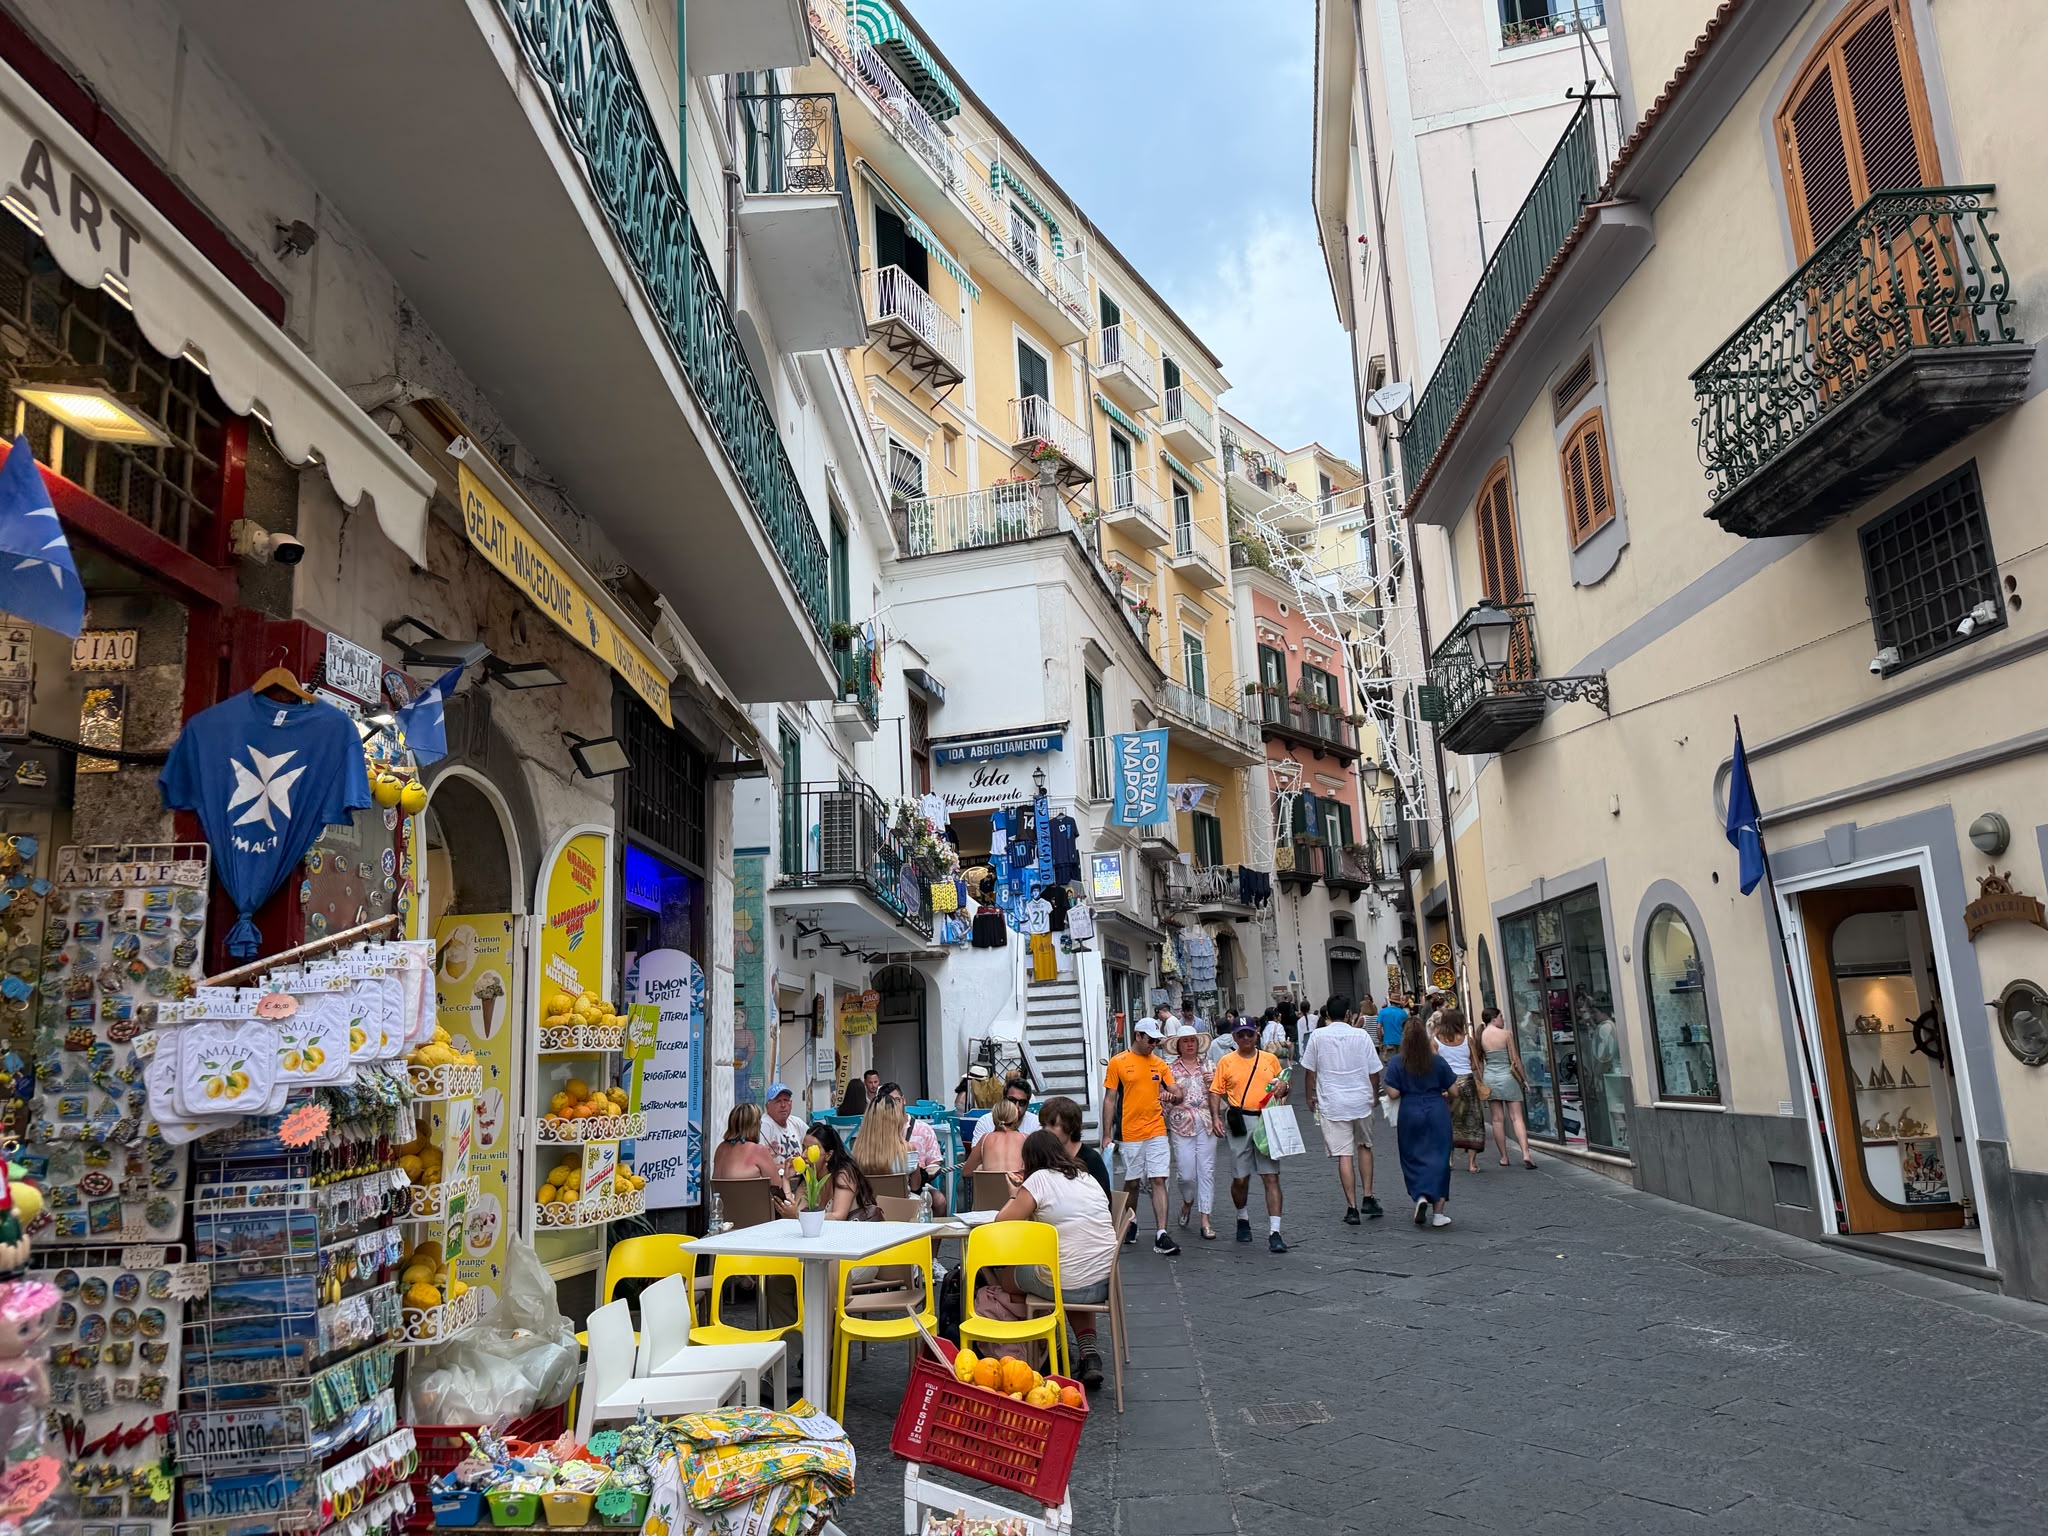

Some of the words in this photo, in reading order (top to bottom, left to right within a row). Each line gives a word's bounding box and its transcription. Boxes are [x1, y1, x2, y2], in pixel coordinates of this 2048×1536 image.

[20, 138, 141, 278] ART
[466, 490, 508, 567] GELATI
[73, 637, 133, 660] CIAO
[333, 659, 378, 689] ITALIA
[948, 748, 965, 760] IDA
[970, 737, 1048, 757] ABBIGLIAMENTO
[969, 766, 1010, 788] Ida
[1121, 735, 1142, 823] NAPOLI
[1138, 739, 1160, 818] FORZA
[1023, 815, 1034, 830] 14
[566, 849, 597, 881] ORANGE
[62, 866, 172, 885] AMALF
[571, 867, 593, 893] JUICE
[552, 898, 598, 928] LIMONCELLO
[1032, 910, 1046, 926] 21
[565, 917, 585, 937] SHOT
[473, 944, 500, 954] Sorbet
[474, 936, 501, 944] Lemon
[645, 977, 688, 996] LEMON
[649, 988, 682, 1004] SPRITZ
[206, 1004, 251, 1015] AMALFI
[441, 1004, 455, 1013] Ice
[456, 1002, 481, 1012] Cream
[660, 1010, 689, 1023] ETTERIA
[1239, 1017, 1247, 1026] N
[197, 1045, 254, 1064] AMALFI
[656, 1039, 689, 1051] TICCERIA
[836, 1055, 849, 1107] GGITORIA
[469, 1152, 487, 1160] nita
[489, 1151, 509, 1160] with
[471, 1164, 492, 1173] Fruit
[638, 1156, 684, 1177] APEROL
[646, 1167, 677, 1184] SPRITZ
[232, 1222, 269, 1233] ITALIA
[455, 1258, 486, 1267] Orange
[458, 1270, 480, 1279] Juice
[238, 1412, 265, 1422] LOVE
[186, 1424, 266, 1461] SORRENTO
[190, 1484, 281, 1519] POSITANO
[745, 1517, 759, 1536] pri
